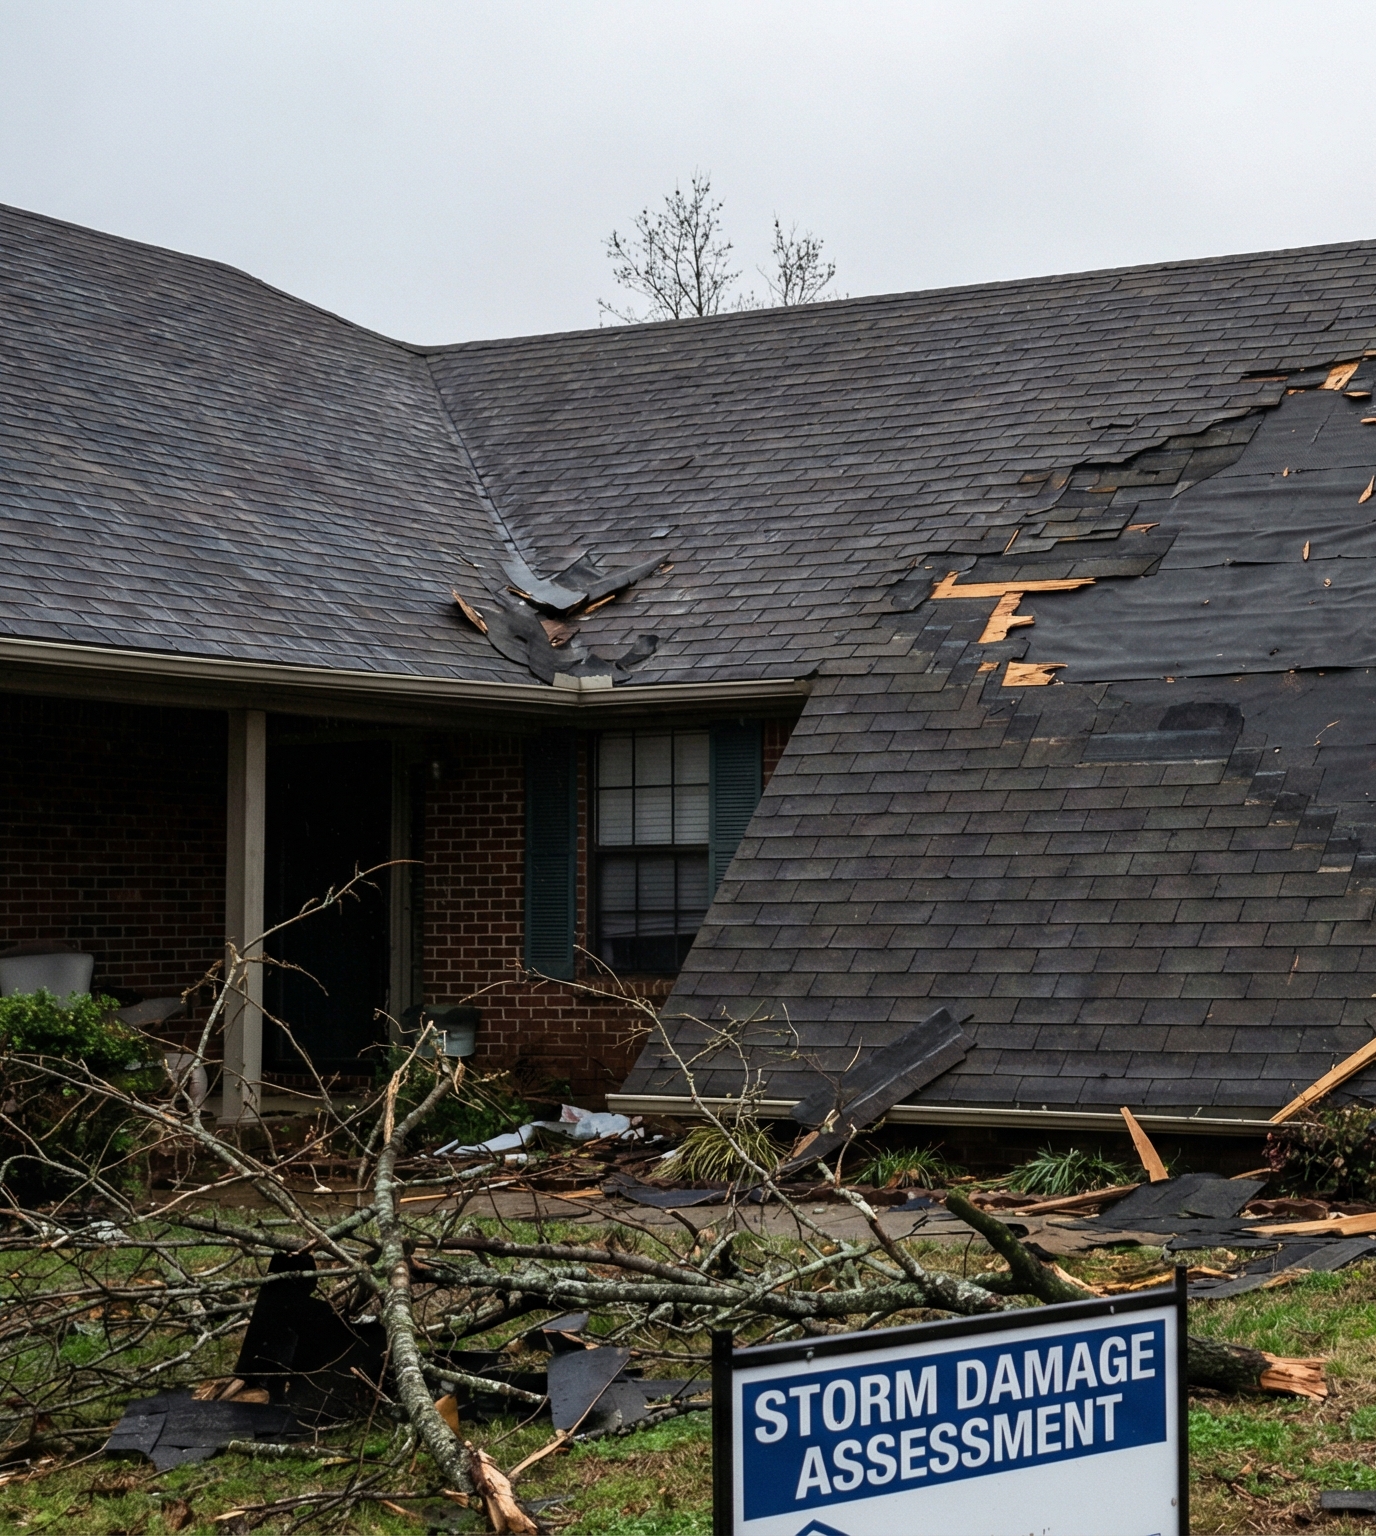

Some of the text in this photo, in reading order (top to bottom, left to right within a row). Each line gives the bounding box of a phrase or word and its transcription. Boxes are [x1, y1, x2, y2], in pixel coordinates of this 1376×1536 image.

[754, 1331, 1156, 1444] STORM DAMAGE
[795, 1393, 1123, 1500] ASSESSMENT
